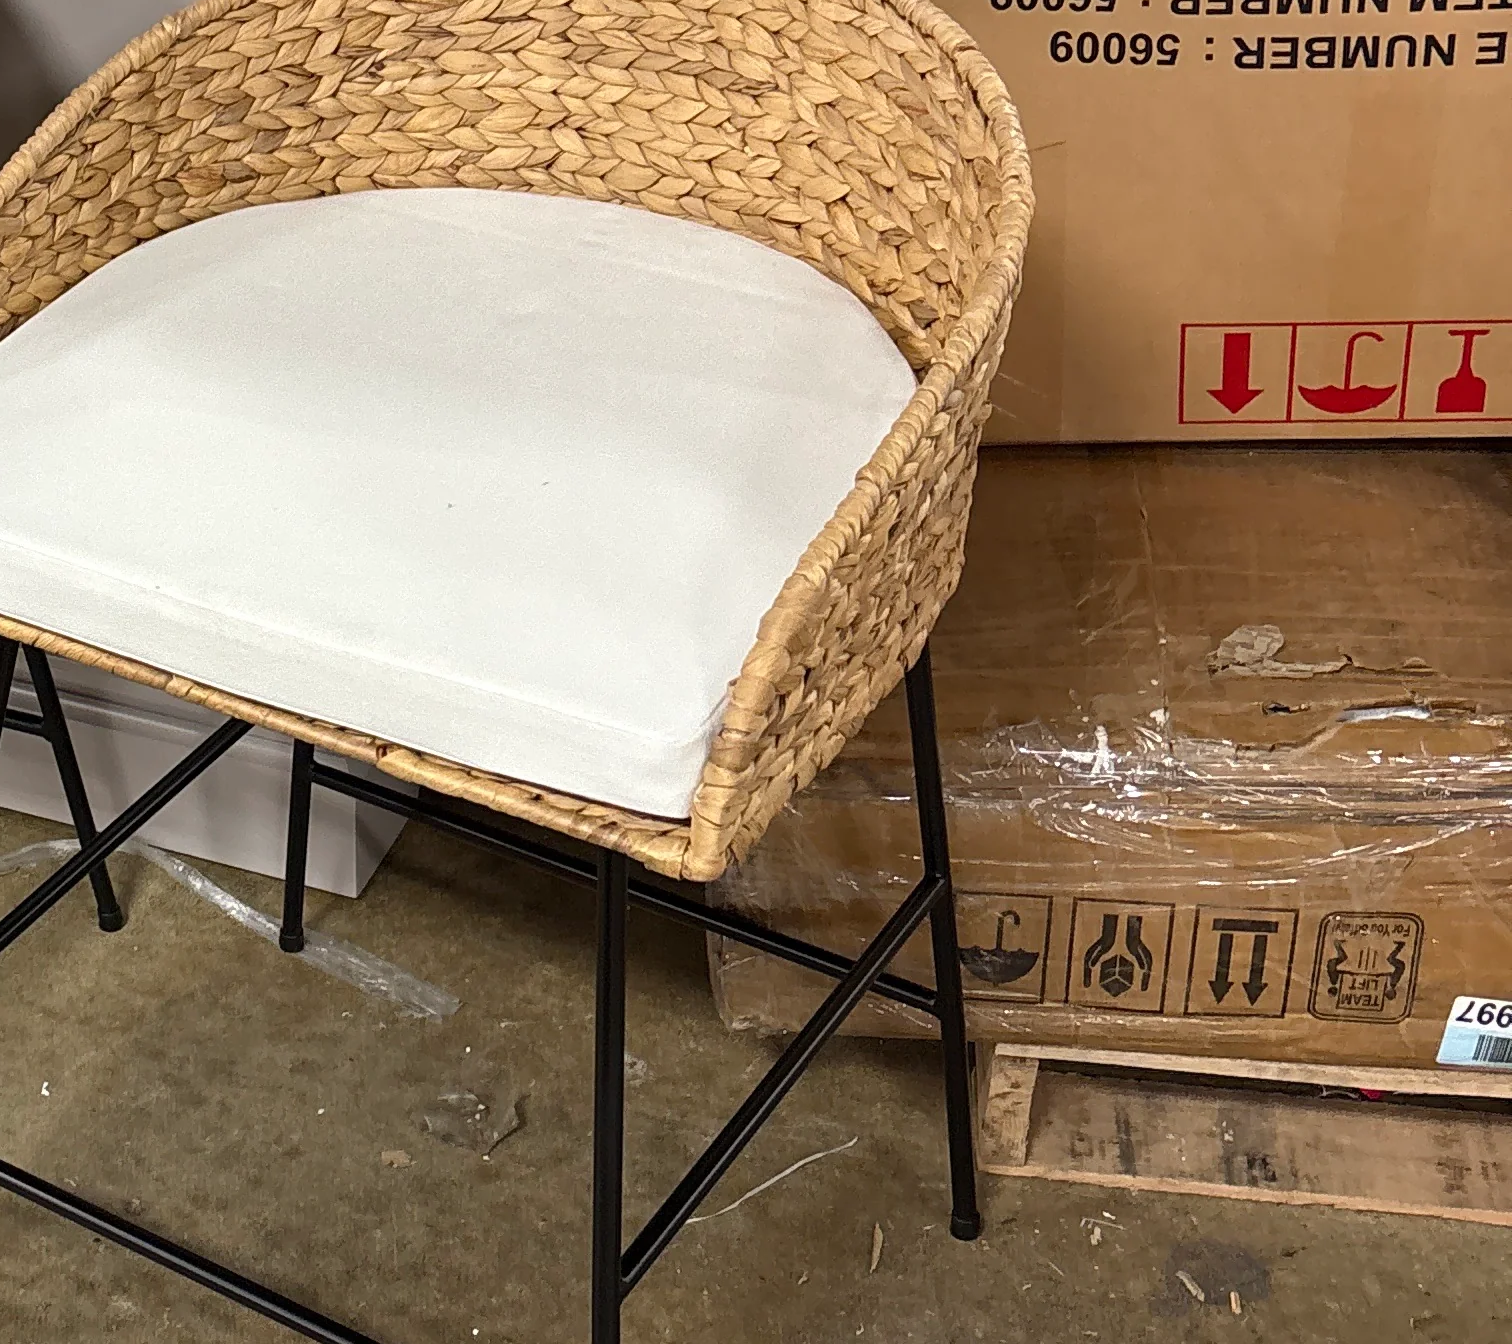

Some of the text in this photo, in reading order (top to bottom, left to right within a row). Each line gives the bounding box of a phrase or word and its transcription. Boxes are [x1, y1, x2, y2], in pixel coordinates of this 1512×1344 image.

[1048, 30, 1181, 67] 56009
[1232, 33, 1457, 70] NUMBER
[1475, 31, 1509, 66] E
[1340, 993, 1381, 1007] TEAM
[1349, 977, 1380, 991] LIFT
[1455, 1000, 1512, 1029] 997
